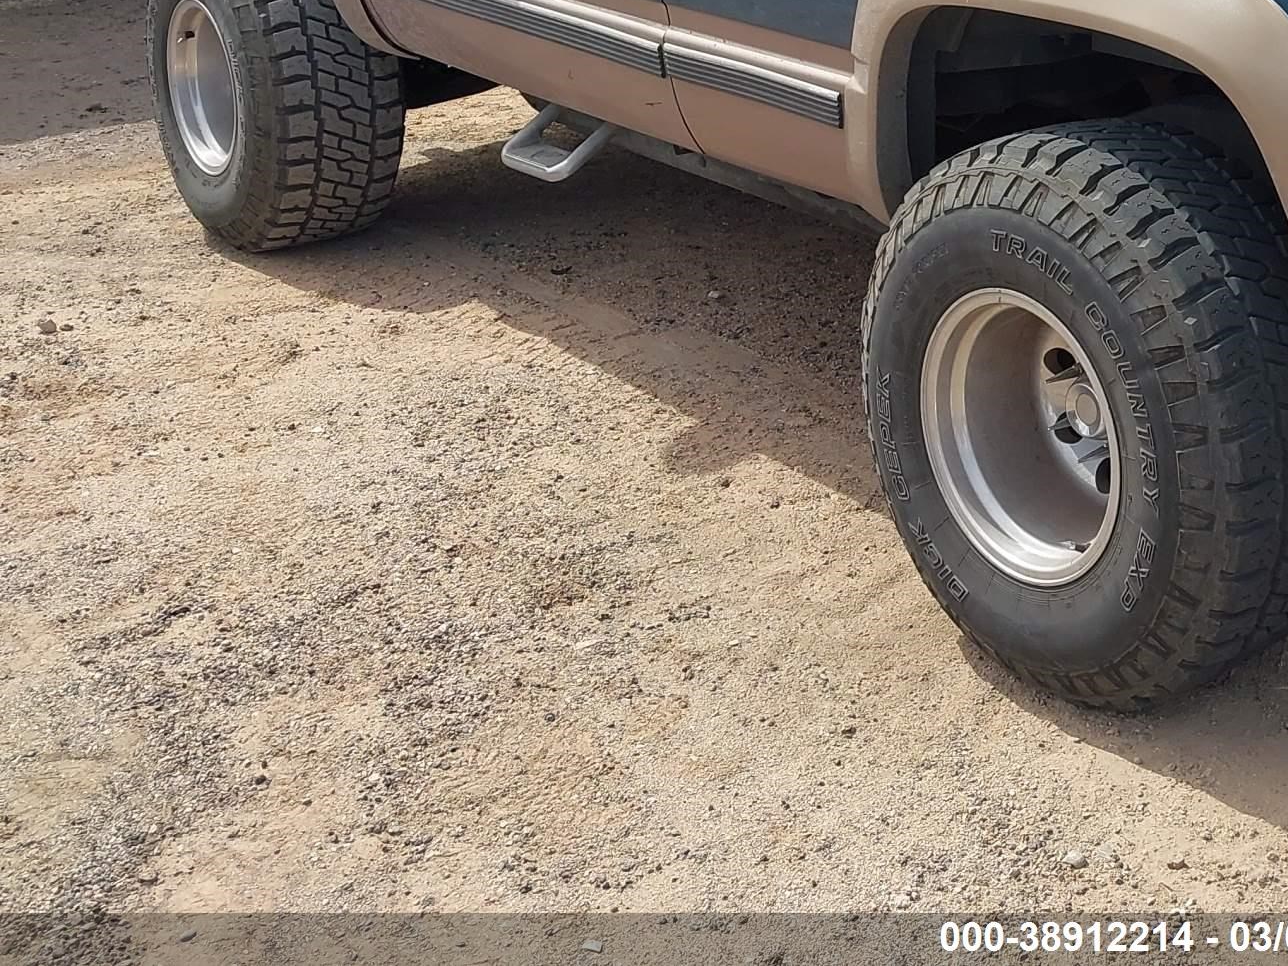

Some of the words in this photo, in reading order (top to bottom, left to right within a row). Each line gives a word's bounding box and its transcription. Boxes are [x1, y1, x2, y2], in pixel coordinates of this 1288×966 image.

[989, 228, 1074, 297] TRAIL
[875, 367, 911, 502] CEPEK
[1084, 300, 1160, 520] COUNTRY
[907, 516, 970, 603] DICK
[1119, 527, 1157, 612] EXP
